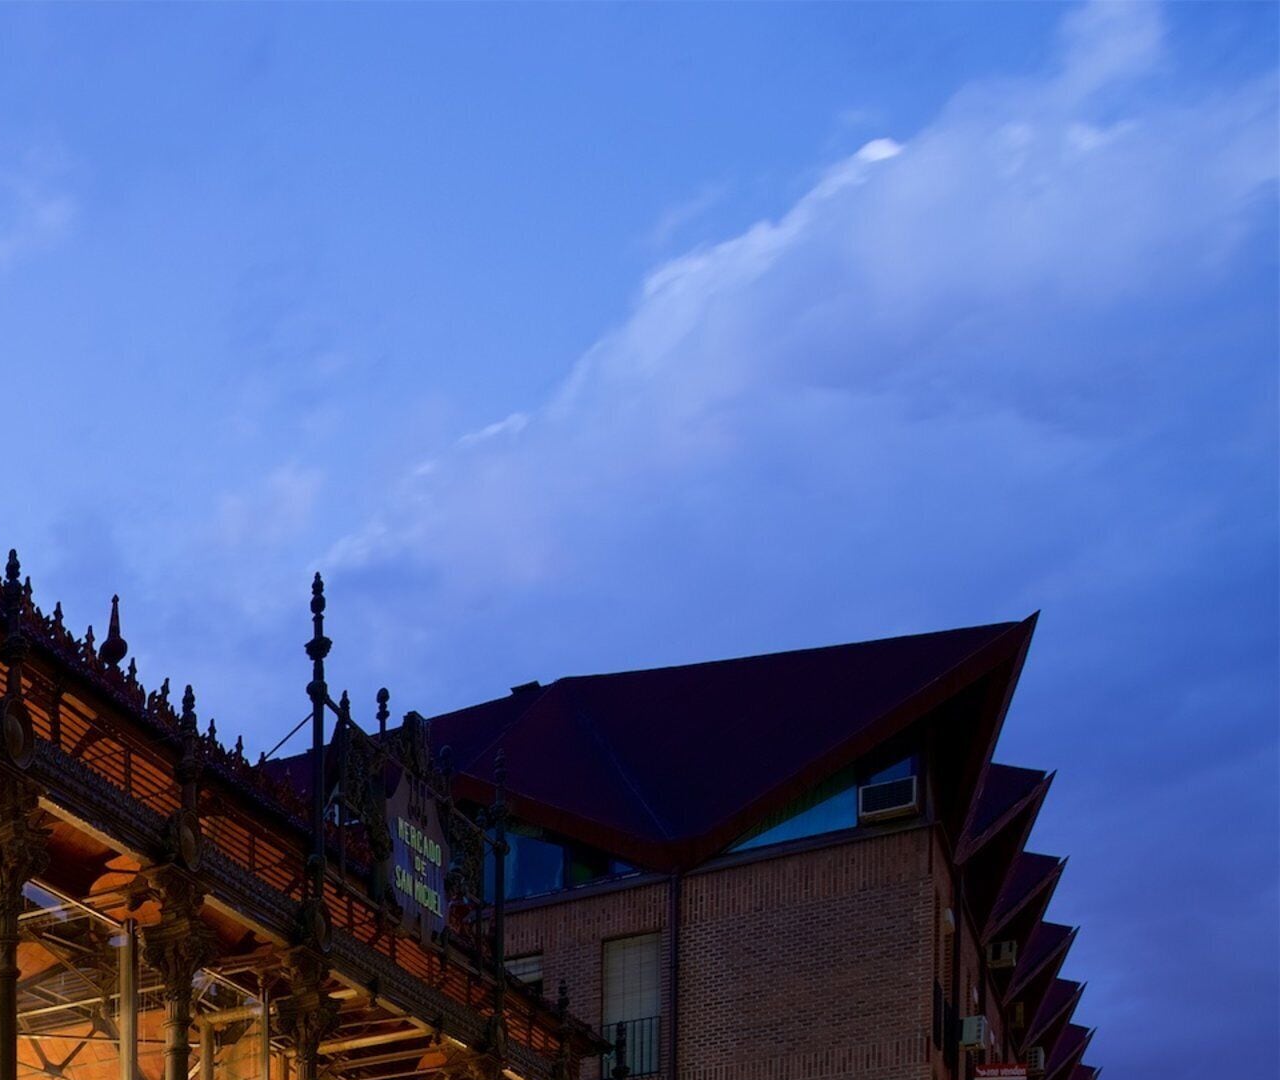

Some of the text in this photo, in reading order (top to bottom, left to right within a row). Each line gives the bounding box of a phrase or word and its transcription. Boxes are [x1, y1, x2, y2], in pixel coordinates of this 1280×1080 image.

[398, 816, 442, 867] MERCADO
[395, 865, 413, 897] SAN
[415, 856, 427, 877] DE
